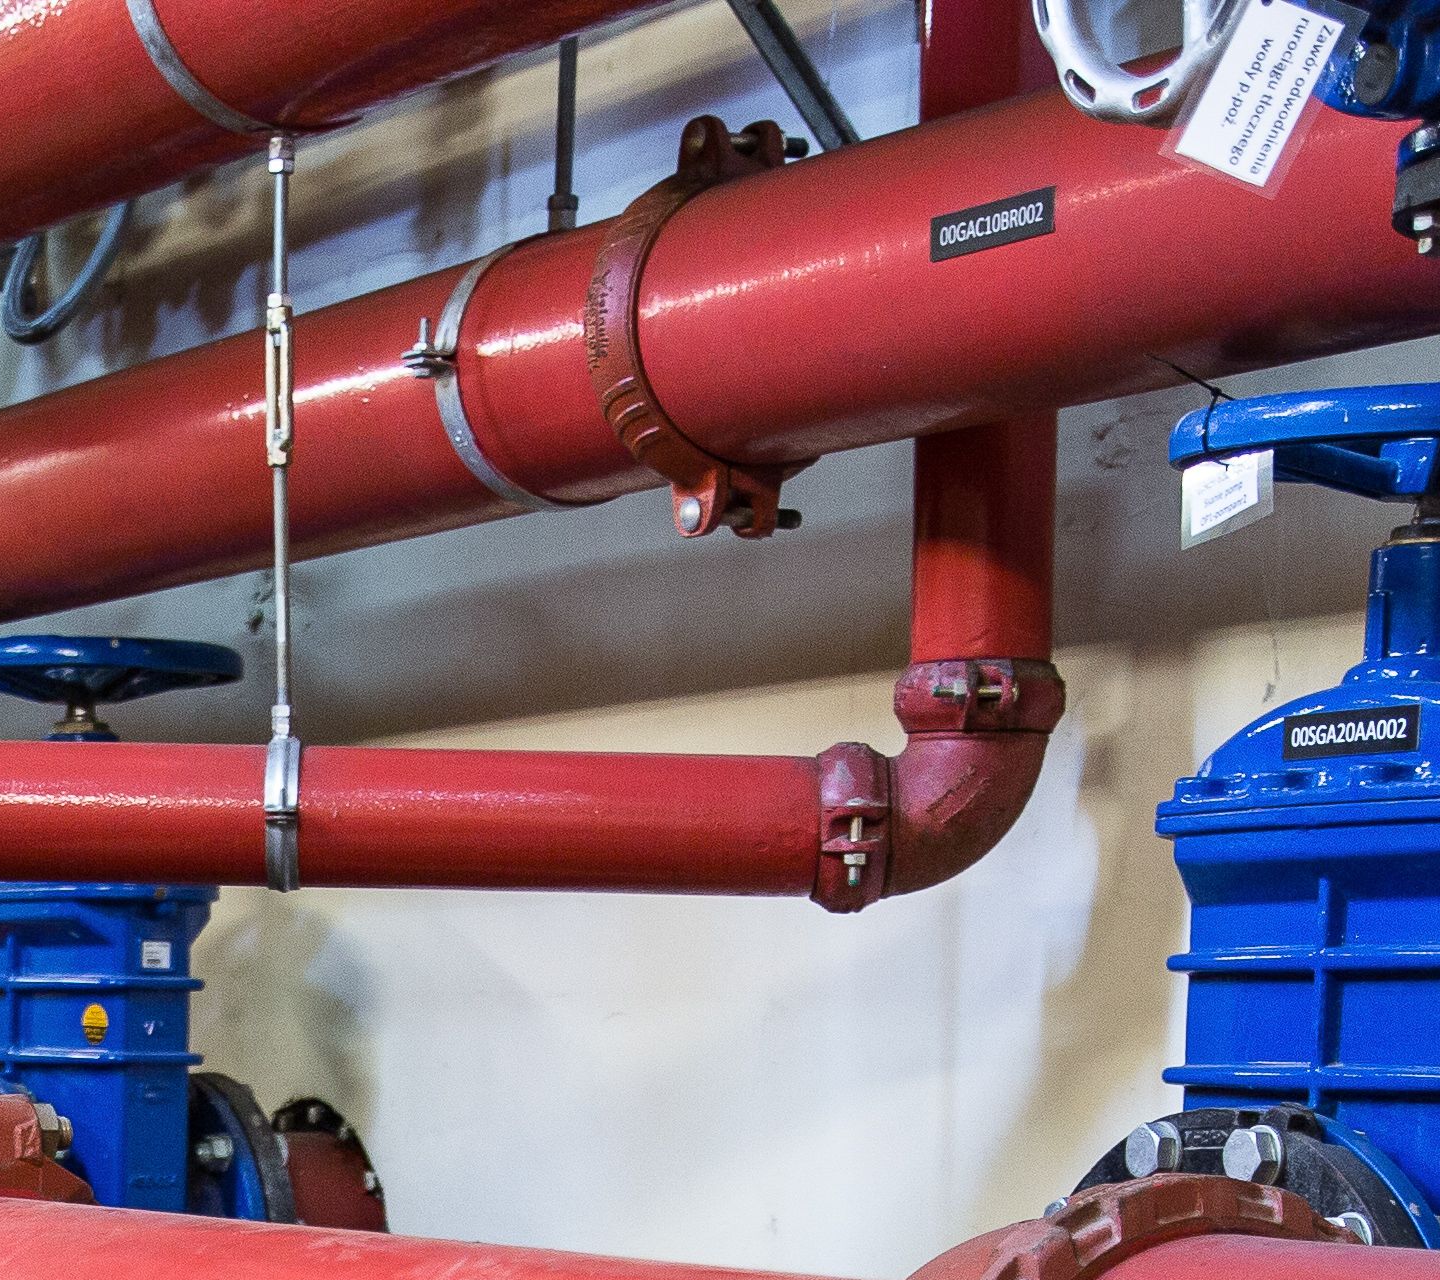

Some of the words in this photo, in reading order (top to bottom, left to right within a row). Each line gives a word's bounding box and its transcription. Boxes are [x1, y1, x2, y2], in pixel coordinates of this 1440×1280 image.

[1243, 37, 1274, 80] wody
[1267, 17, 1310, 91] rurociągu
[1305, 24, 1335, 75] Zawór
[1229, 93, 1273, 167] tłocznego
[1249, 77, 1306, 175] odwodnienia
[939, 202, 1044, 246] 00GAC10BR002
[1290, 717, 1407, 748] 00SGA20AA002
